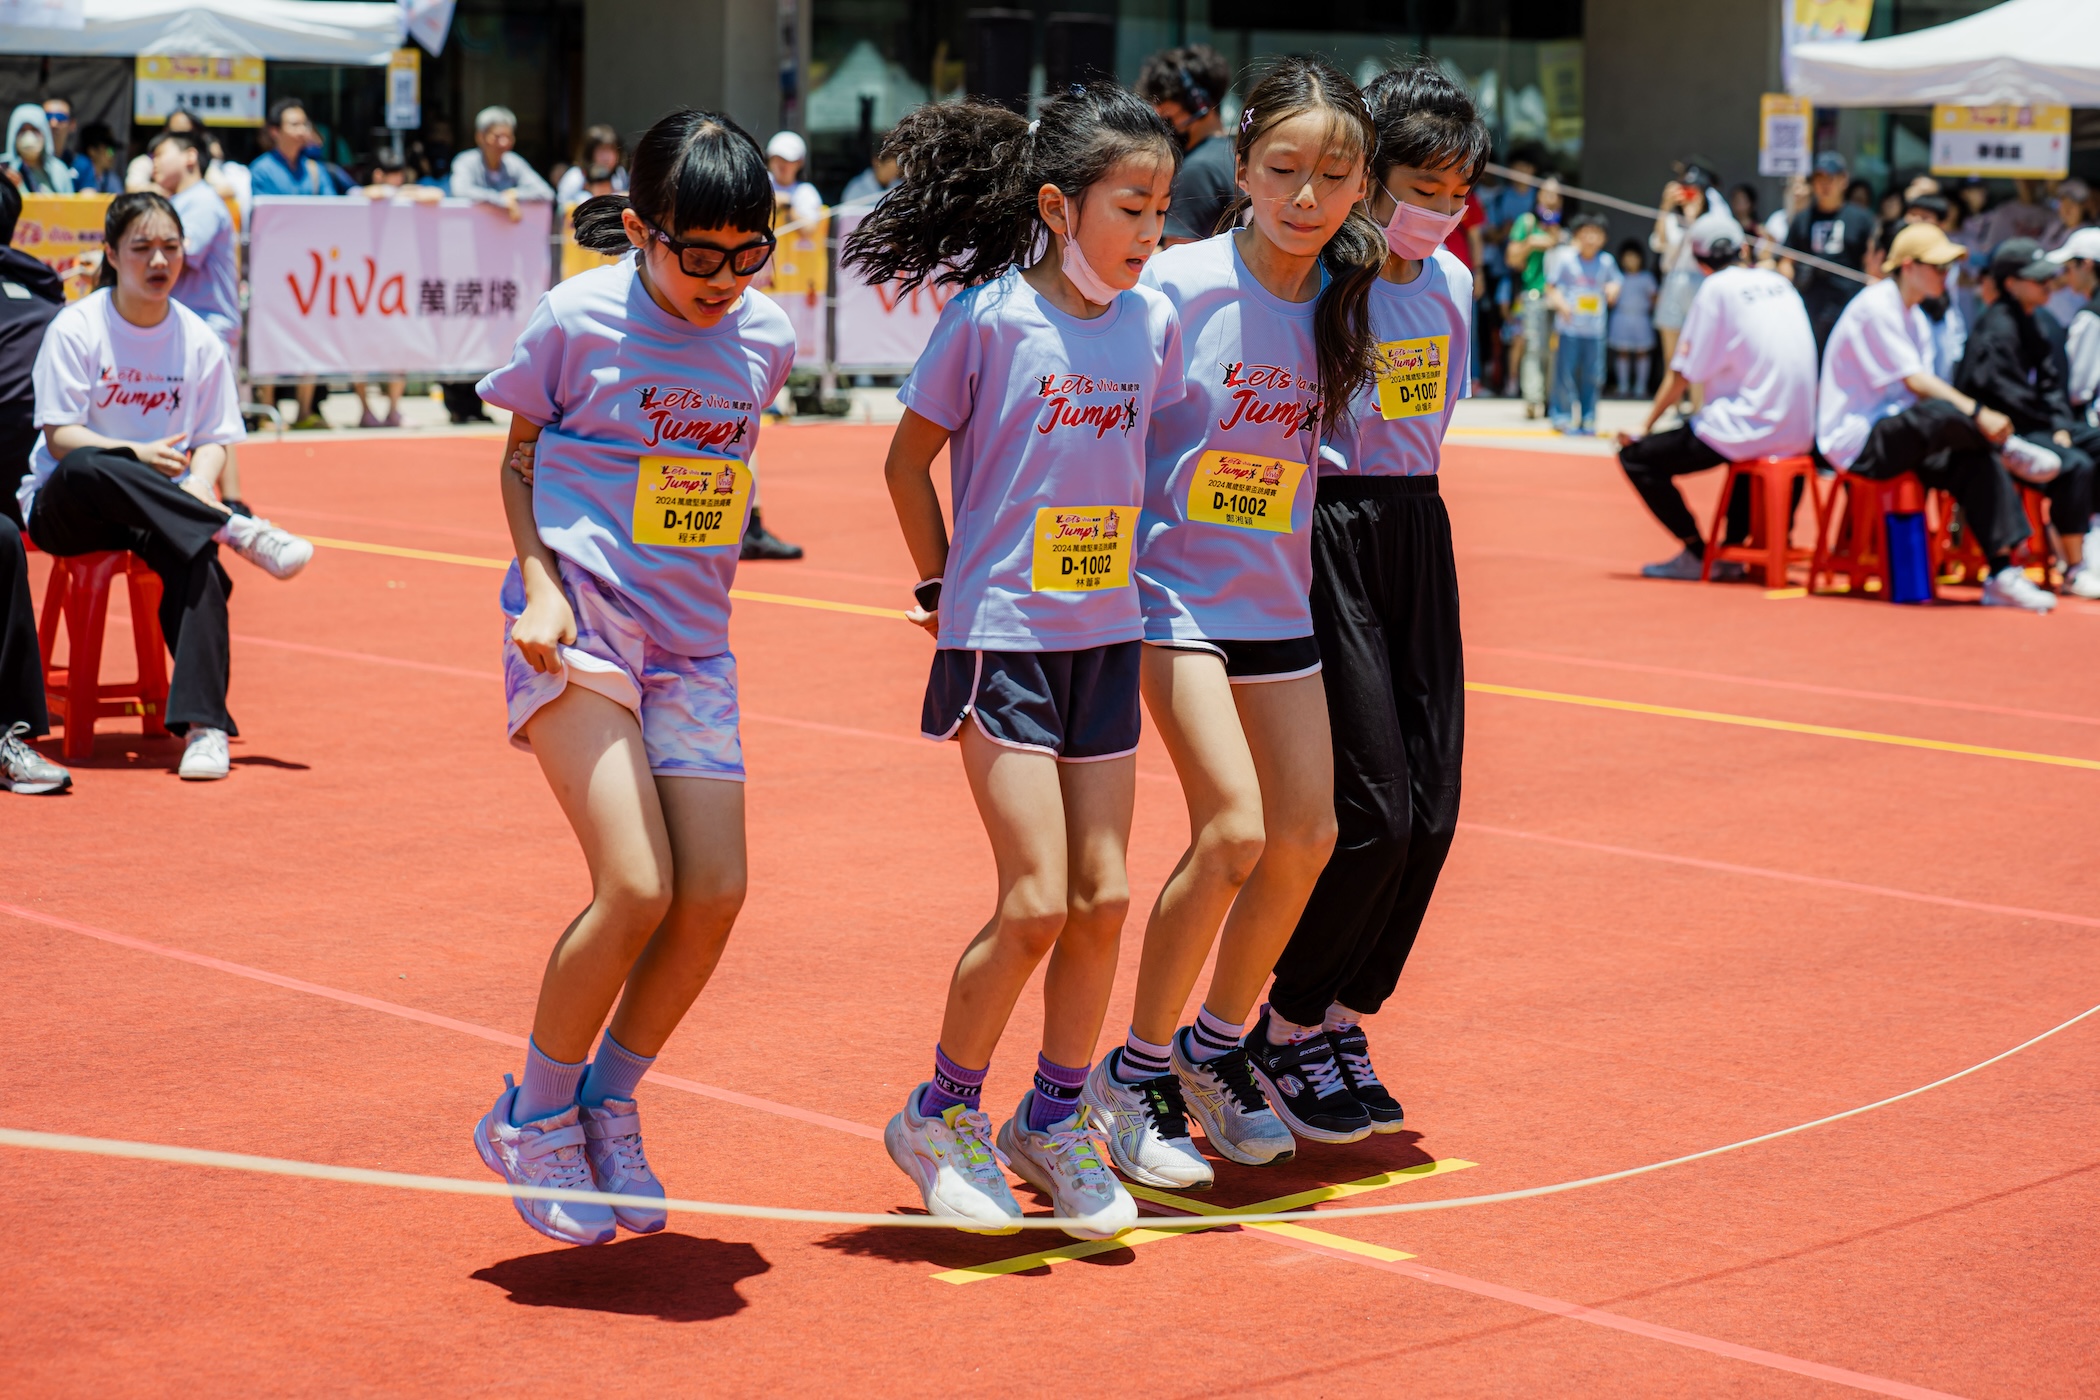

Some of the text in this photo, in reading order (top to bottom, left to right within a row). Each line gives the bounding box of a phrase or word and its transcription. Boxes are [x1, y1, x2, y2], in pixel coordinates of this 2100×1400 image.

[1043, 374, 1094, 397] Let's
[1226, 362, 1292, 390] Let's
[643, 386, 703, 411] Let's
[1400, 381, 1438, 403] D-1002
[1038, 396, 1136, 439] Jump!
[643, 410, 748, 451] Jump!
[1214, 463, 1256, 480] Jump!
[660, 476, 707, 494] Jump!
[1208, 480, 1225, 488] 2024
[656, 496, 676, 505] 2024
[1213, 491, 1267, 517] D-1002
[664, 509, 722, 530] D-1002
[1055, 523, 1097, 541] Jump!
[1061, 554, 1111, 575] D-1002
